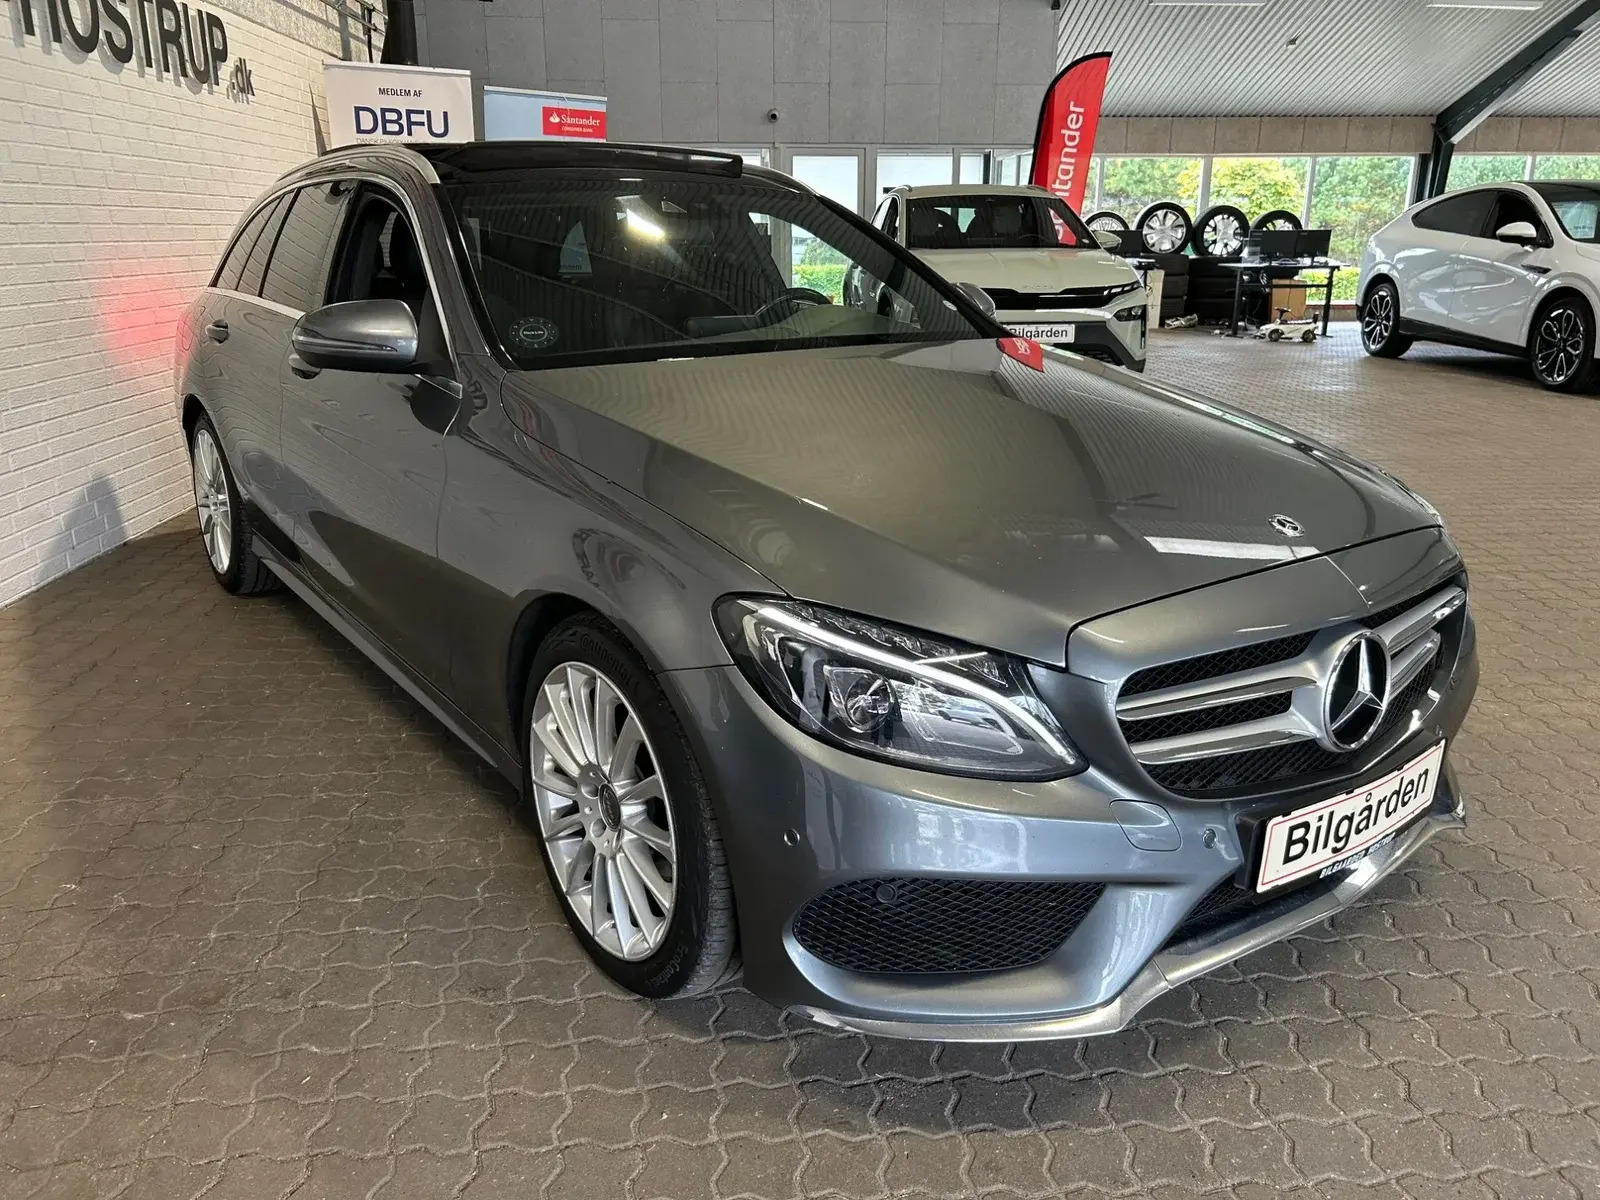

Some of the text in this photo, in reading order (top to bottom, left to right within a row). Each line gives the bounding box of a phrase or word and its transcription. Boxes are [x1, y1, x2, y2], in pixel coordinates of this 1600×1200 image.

[378, 87, 422, 97] MEDLEM AF
[353, 105, 449, 138] DBFU
[561, 114, 600, 126] Santander
[1282, 767, 1429, 866] Bilgården
